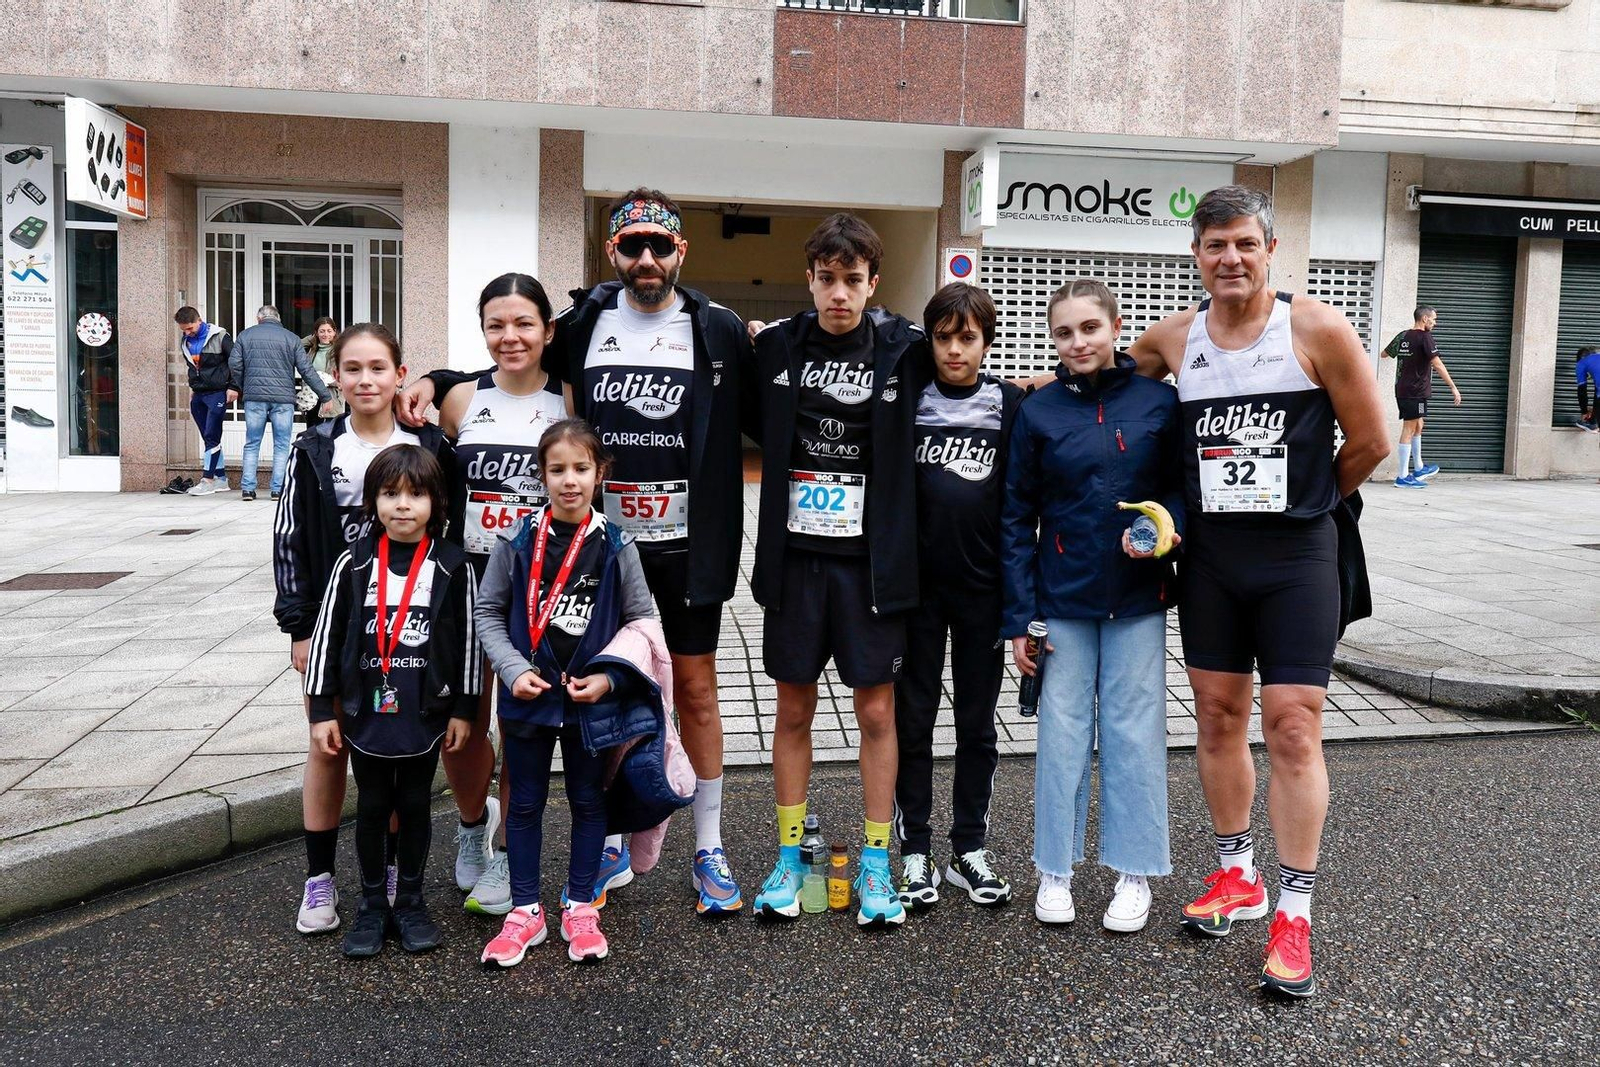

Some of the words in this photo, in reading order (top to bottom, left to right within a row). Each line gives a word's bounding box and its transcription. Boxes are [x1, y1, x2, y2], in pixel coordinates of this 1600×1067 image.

[1086, 216, 1150, 226] CIGARRILLOS
[1520, 216, 1554, 230] CUM
[593, 372, 685, 404] delikia
[838, 388, 861, 396] fresh
[642, 401, 666, 412] fresh
[1195, 403, 1287, 438] delikia
[1244, 429, 1268, 442] fresh
[915, 436, 996, 466] delikia
[961, 464, 983, 473] fresh
[1223, 461, 1256, 485] 32
[518, 481, 542, 492] fresh
[798, 484, 846, 512] 202
[620, 496, 670, 519] 557
